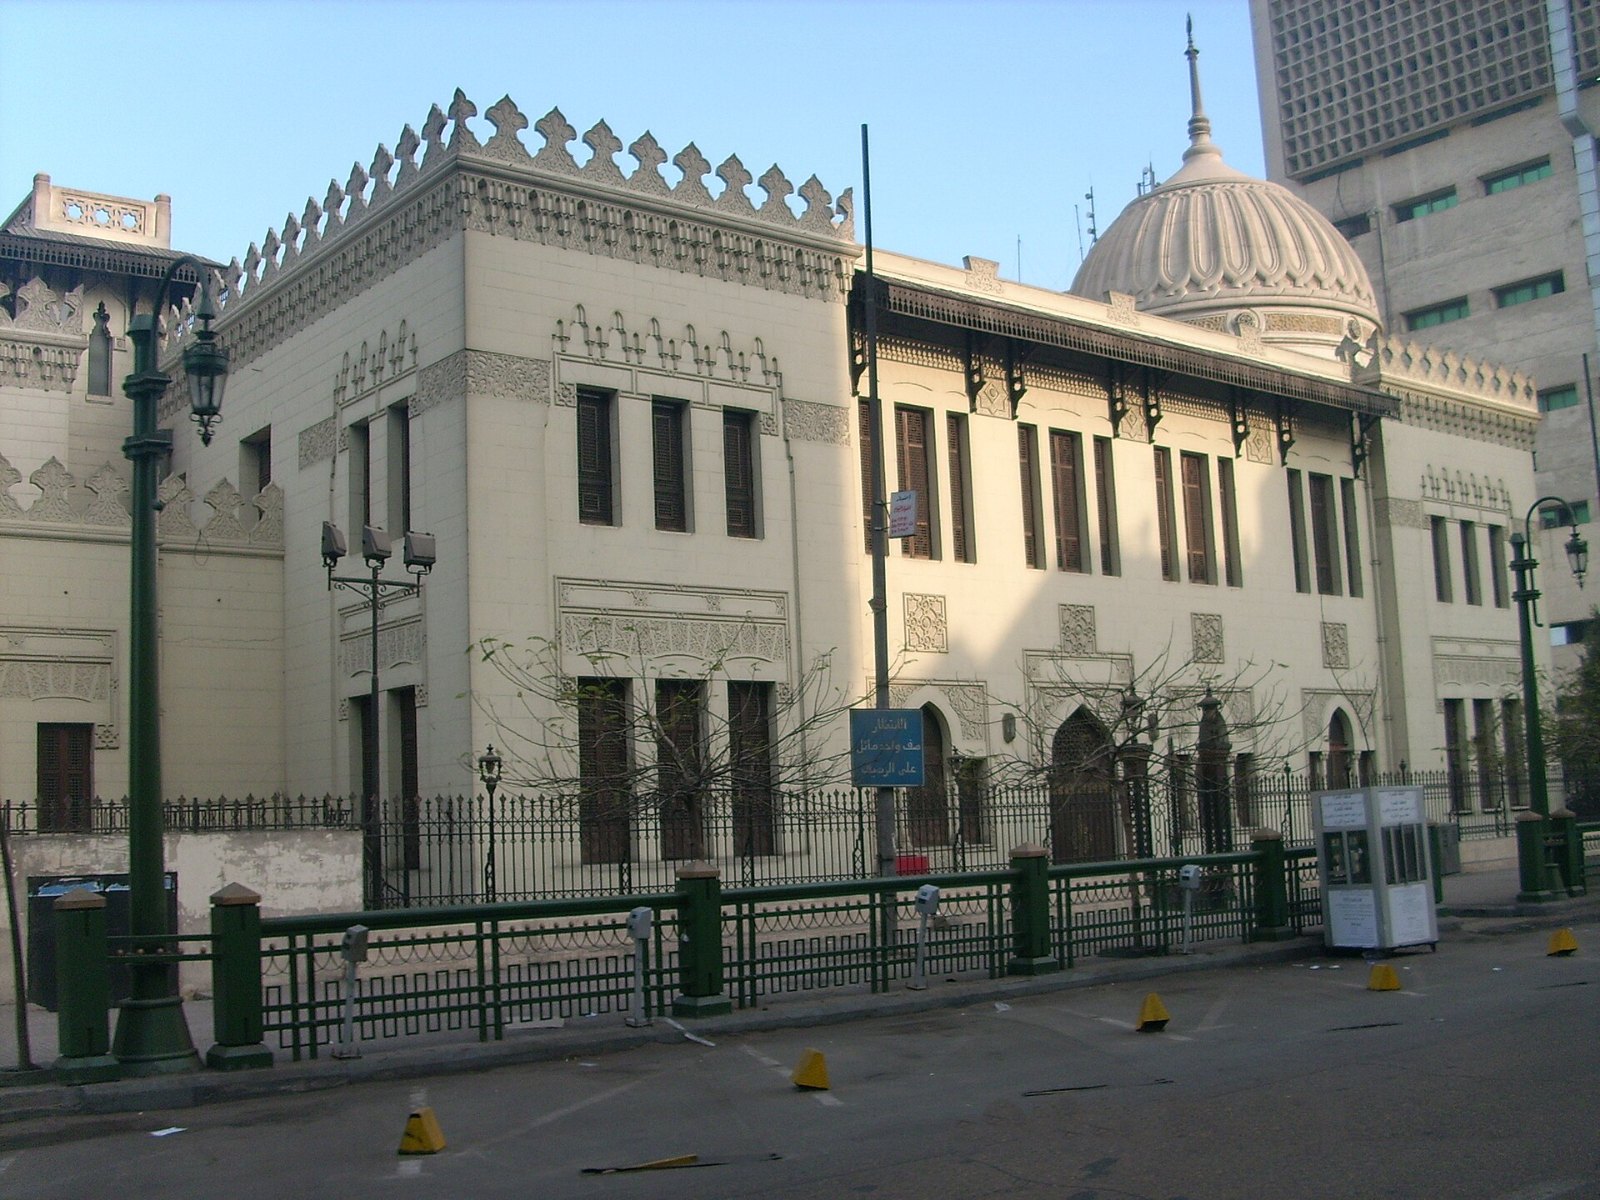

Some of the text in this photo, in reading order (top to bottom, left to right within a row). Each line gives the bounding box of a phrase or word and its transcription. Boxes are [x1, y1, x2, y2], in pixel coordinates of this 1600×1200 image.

[872, 717, 907, 733] الانتظار
[880, 740, 900, 753] واحد
[902, 739, 921, 751] صف
